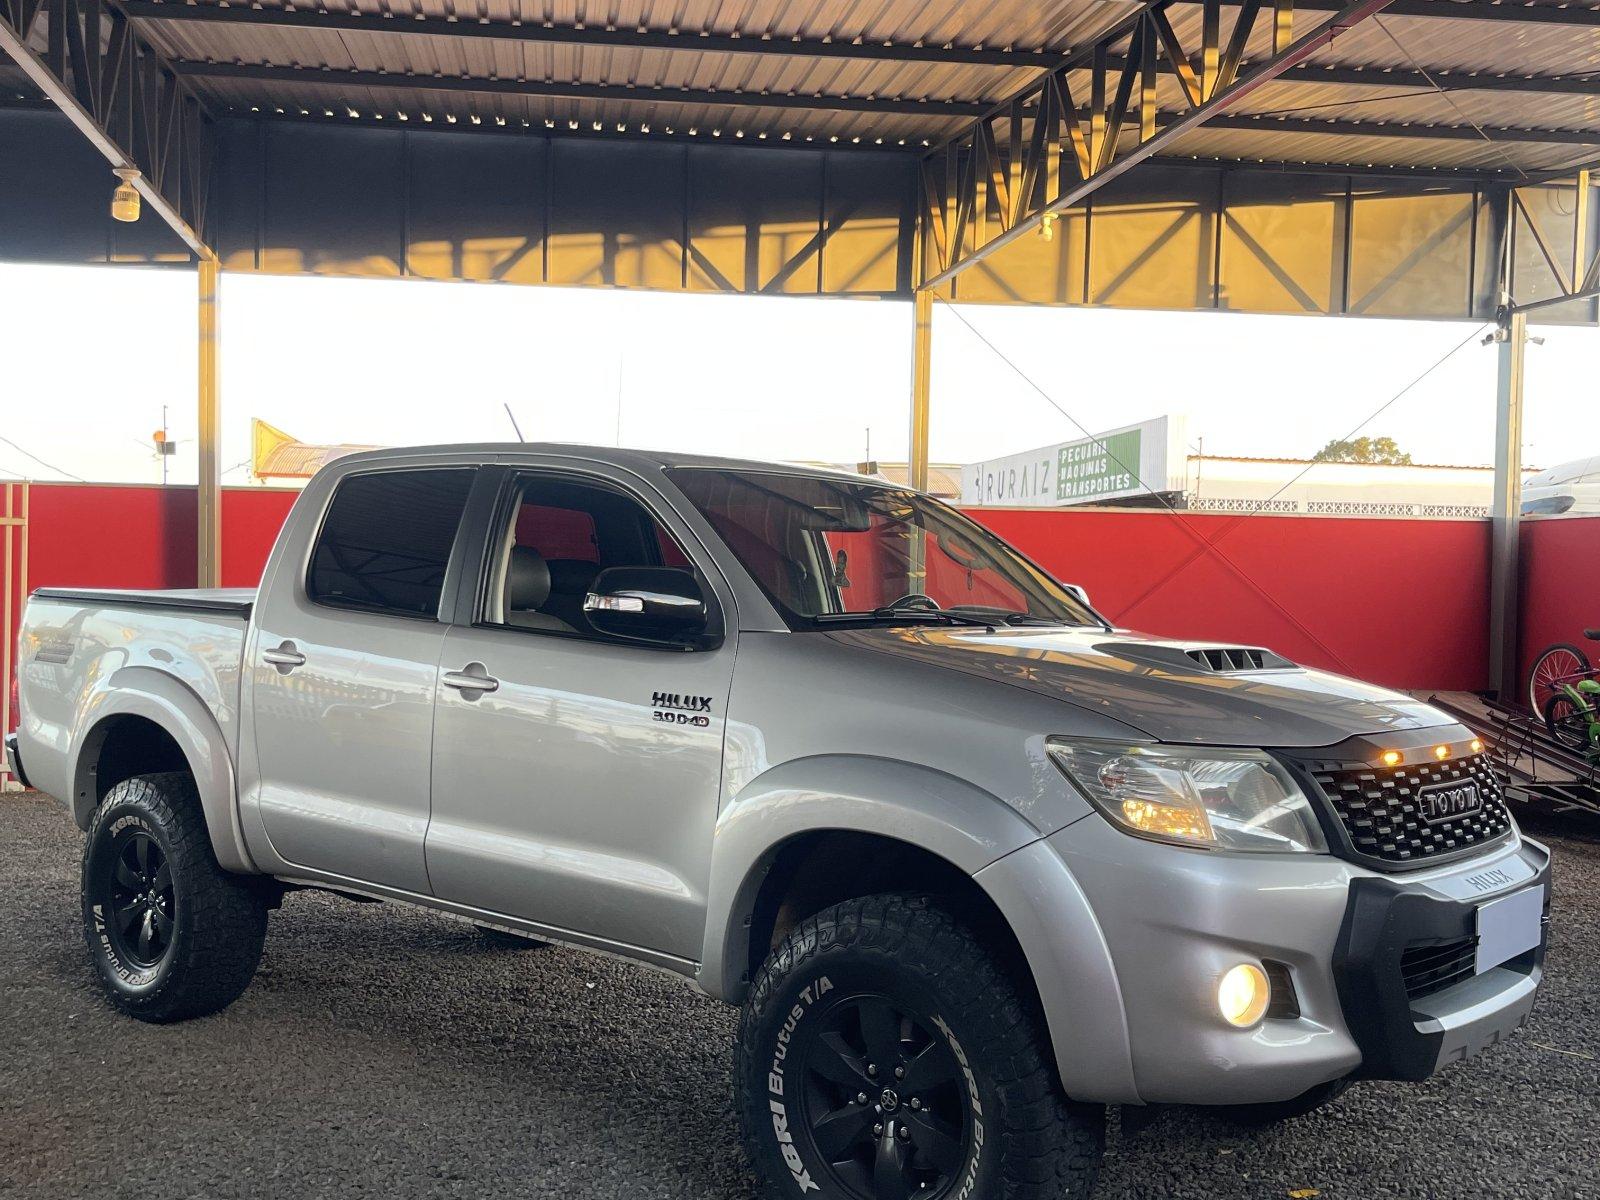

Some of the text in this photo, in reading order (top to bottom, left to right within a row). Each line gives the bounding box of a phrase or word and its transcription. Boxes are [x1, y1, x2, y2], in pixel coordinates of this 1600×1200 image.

[1060, 473, 1130, 498] TRANSPORTES
[651, 691, 713, 712] HILUX
[1424, 785, 1479, 816] TOYOTA
[1465, 869, 1514, 891] HILUX
[768, 975, 834, 1194] XBRI Brutus T/A
[955, 1118, 984, 1200] Brutu
